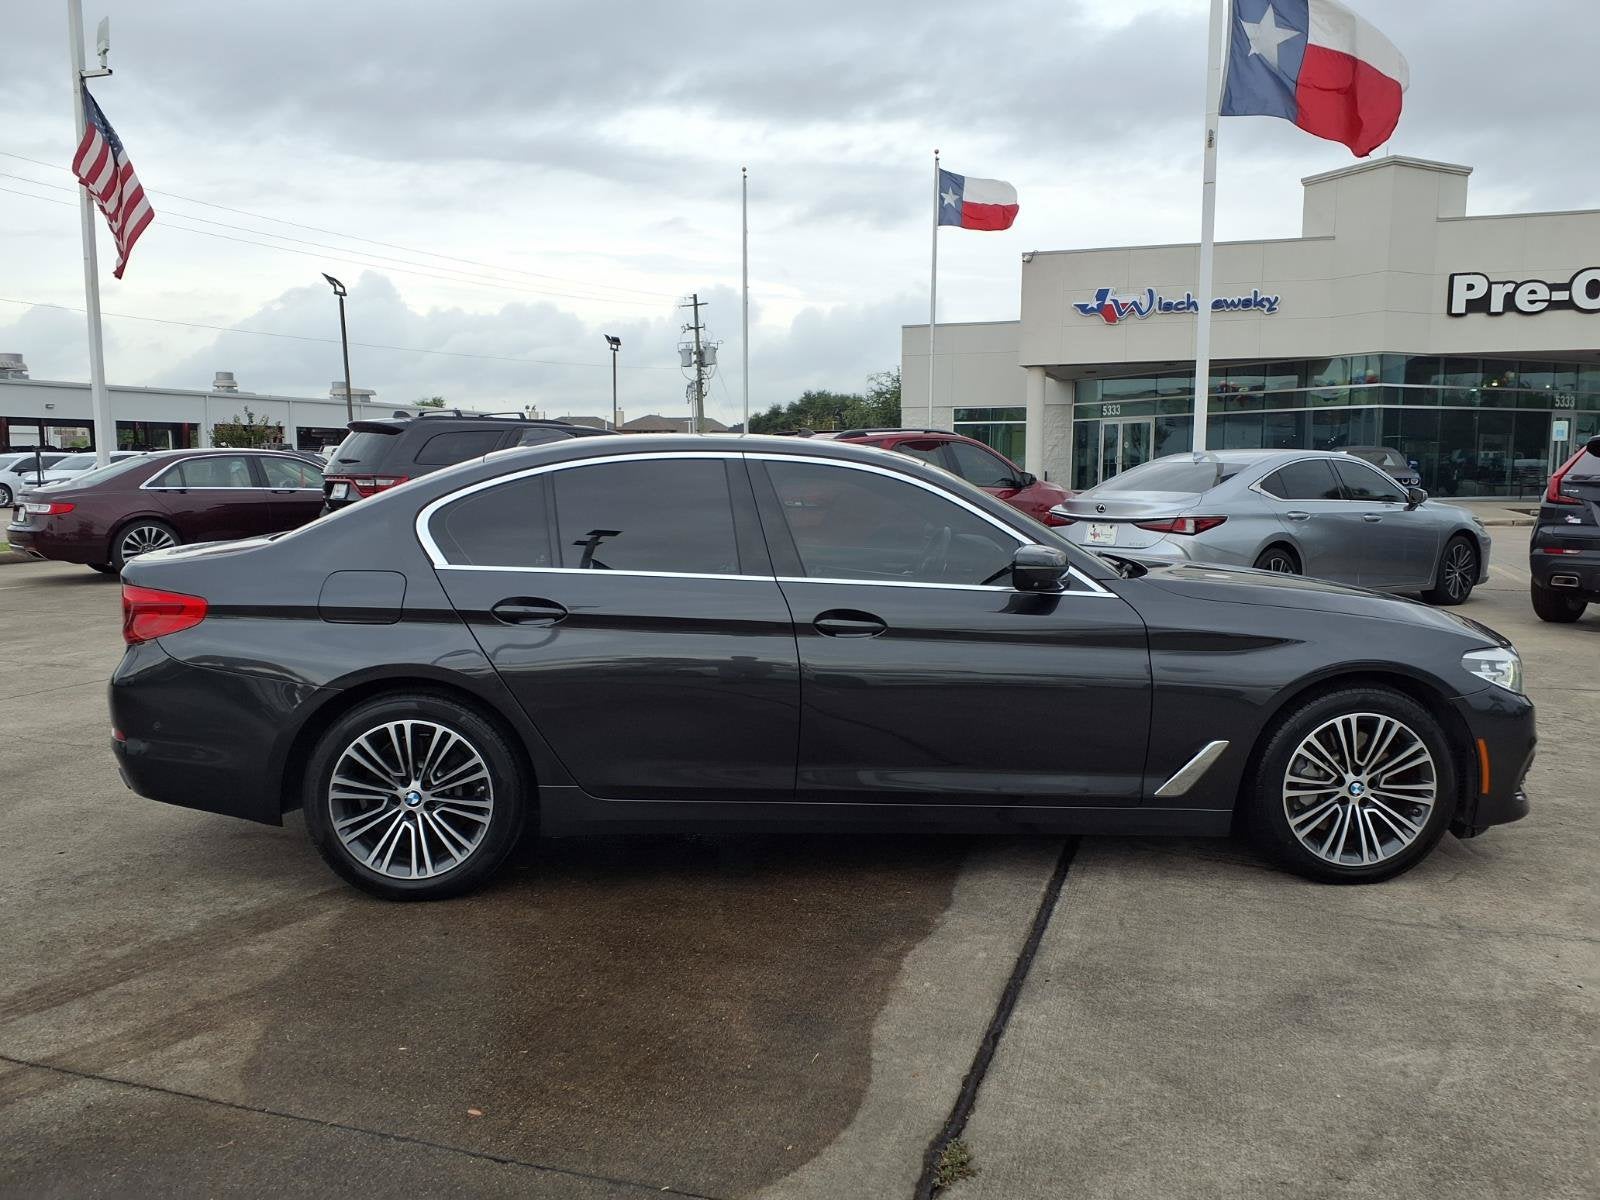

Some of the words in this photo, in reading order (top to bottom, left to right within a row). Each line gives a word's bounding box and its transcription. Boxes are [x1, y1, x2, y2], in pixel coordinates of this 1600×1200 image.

[1110, 288, 1279, 317] Wischewsky
[1555, 395, 1575, 408] 5333
[1102, 404, 1121, 416] 5333
